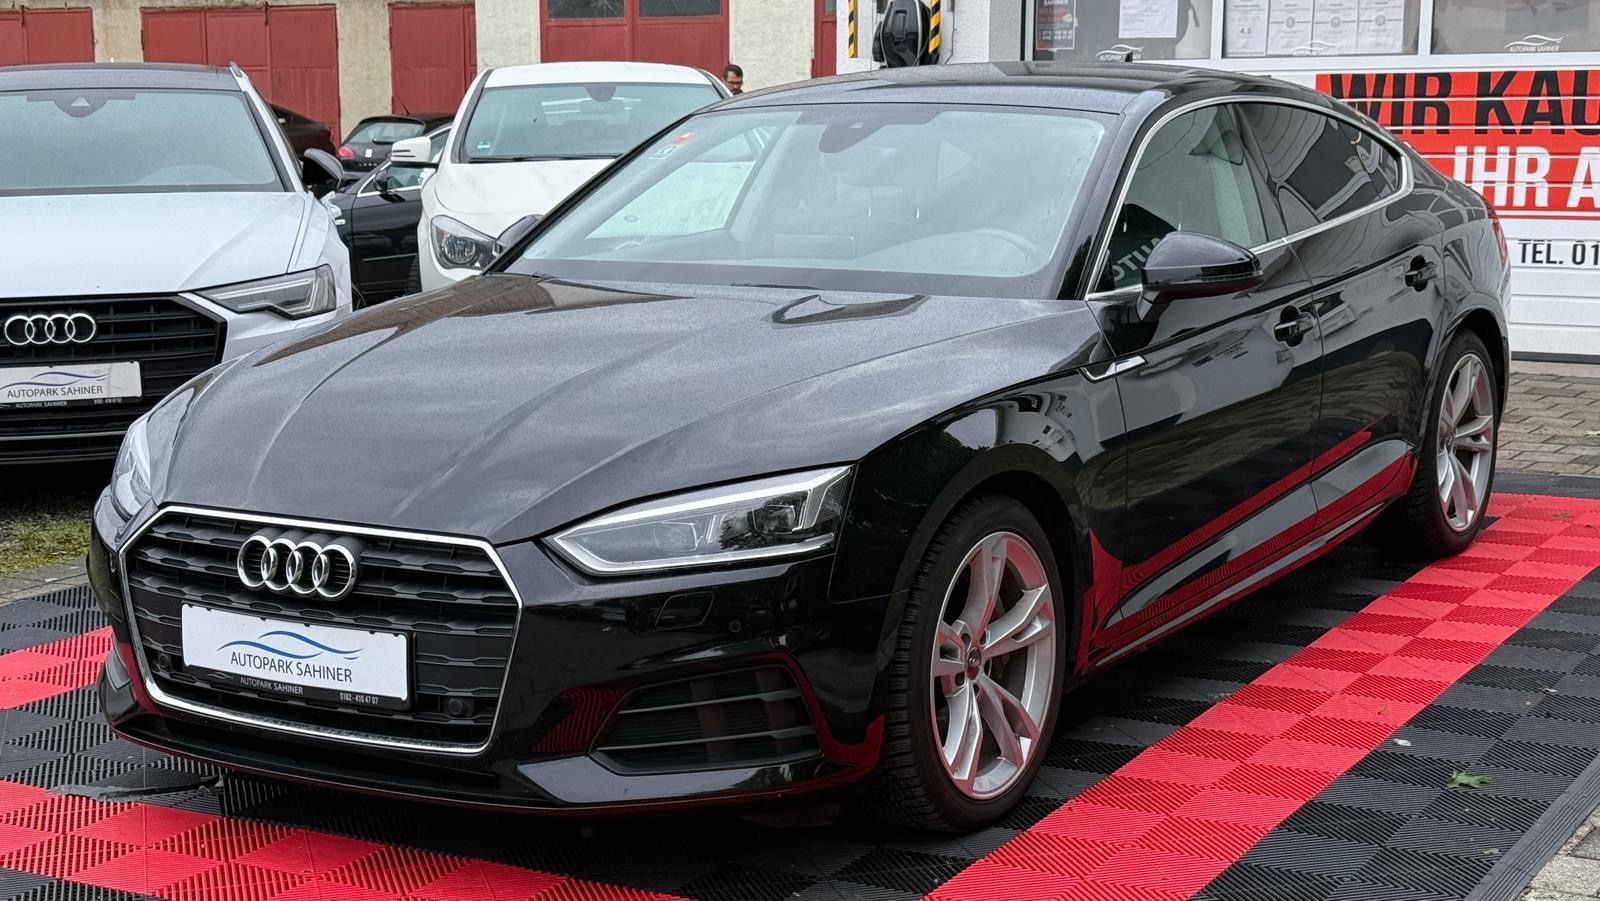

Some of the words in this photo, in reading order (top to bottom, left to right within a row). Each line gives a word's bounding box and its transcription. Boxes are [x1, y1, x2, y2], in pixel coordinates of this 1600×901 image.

[1329, 72, 1452, 135] WIR
[1453, 146, 1551, 208] IHR
[1518, 239, 1563, 264] TEL.
[8, 388, 58, 398] AUTOPARK
[61, 386, 103, 396] SAHINER
[231, 652, 293, 675] AUTOPARK
[296, 662, 352, 683] SAHINER
[240, 677, 272, 690] AUTOPARK
[274, 682, 304, 695] SAHINER
